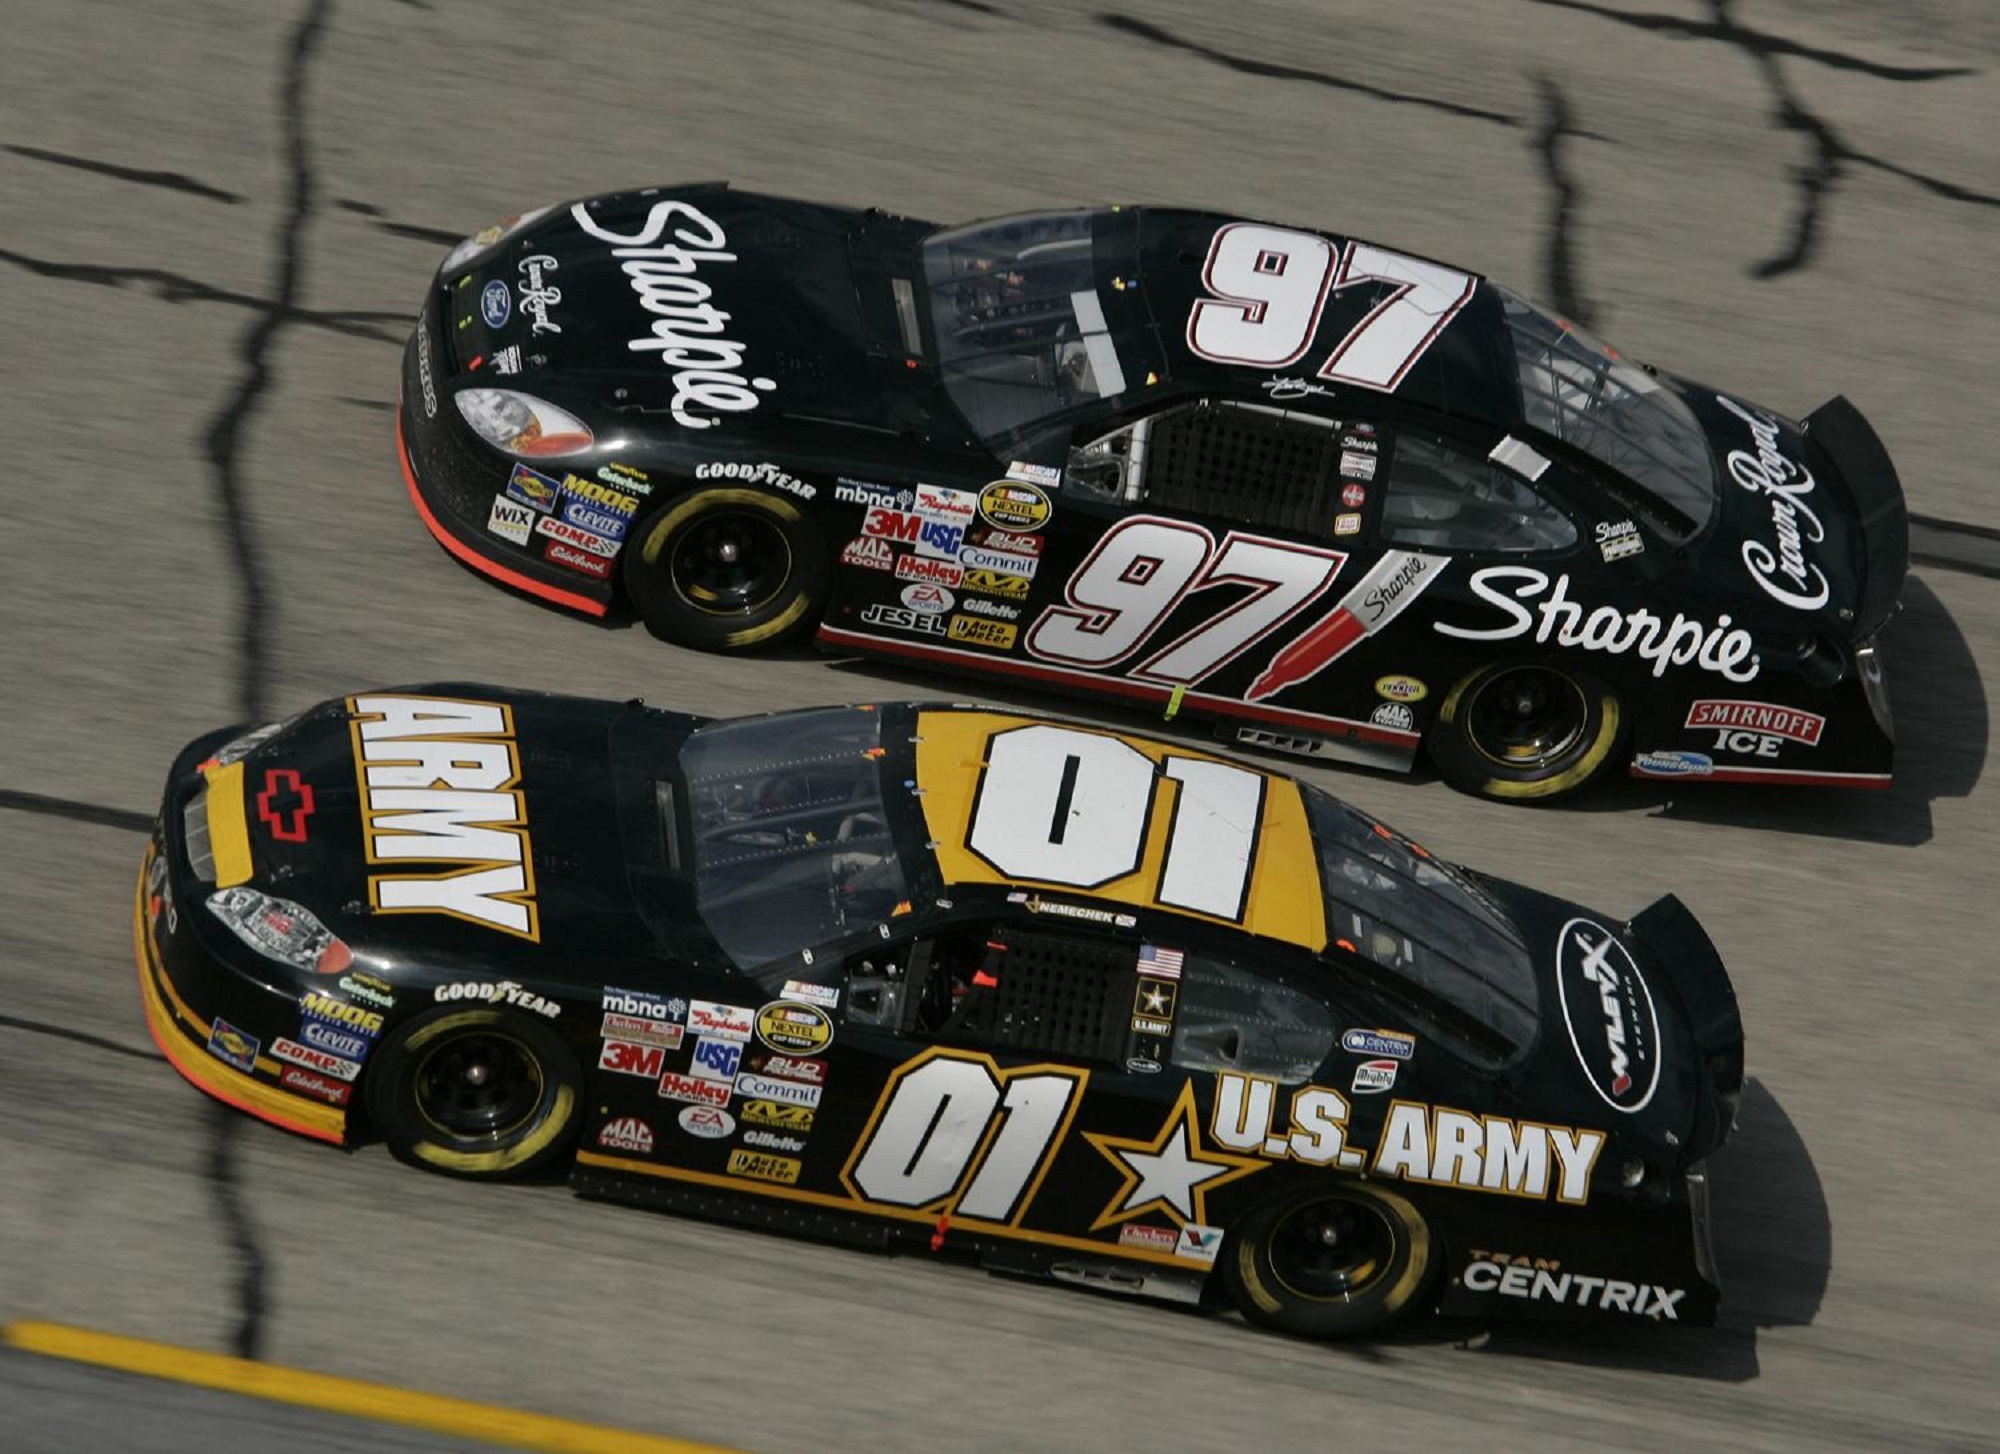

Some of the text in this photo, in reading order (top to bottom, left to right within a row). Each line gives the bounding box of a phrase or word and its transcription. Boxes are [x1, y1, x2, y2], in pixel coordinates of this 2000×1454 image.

[571, 200, 777, 429] Sharpie
[1187, 223, 1477, 393] 97
[563, 474, 640, 513] MOOG
[696, 462, 817, 500] GOODYEAR
[834, 485, 896, 509] mbna
[992, 500, 1034, 515] NEXTEL
[495, 505, 529, 526] WIX
[568, 503, 622, 533] CLEVITE
[865, 509, 922, 541] 3M
[541, 518, 599, 548] COMP
[921, 521, 963, 555] USG
[987, 531, 1036, 547] BUD
[842, 555, 892, 571] TOOLS
[843, 537, 893, 561] MAC
[958, 548, 1034, 574] Commit
[898, 556, 962, 587] Holley
[912, 584, 943, 604] EA
[1024, 514, 1349, 687] 97
[1363, 553, 1427, 622] Sharpie
[908, 598, 944, 612] SPORTS
[963, 597, 1018, 619] Gillette
[861, 604, 947, 636] JESEL
[972, 621, 1005, 634] Auto
[1433, 565, 1760, 683] Sharpie
[965, 628, 1010, 644] Meter
[1695, 704, 1816, 738] SMIRNOFF
[1713, 729, 1784, 758] ICE
[345, 694, 541, 943] ARMY
[965, 723, 1268, 925] 01
[1040, 902, 1114, 923] NEMECHEK
[300, 992, 385, 1031] MOOG
[434, 981, 562, 1019] GOODYEAR
[602, 994, 667, 1019] mbna
[306, 1023, 363, 1054] CLEVITE
[771, 1021, 816, 1037] NEXTEL
[275, 1041, 337, 1068] COMP
[603, 1042, 663, 1076] 3M
[696, 1041, 739, 1077] USG
[768, 1056, 820, 1073] BUD
[662, 1074, 728, 1104] Holley
[737, 1075, 816, 1103] Commit
[603, 1118, 653, 1143] MAC
[690, 1108, 724, 1128] EA
[601, 1136, 652, 1152] TOOLS
[743, 1130, 802, 1151] Gillette
[844, 1049, 1086, 1225] 01
[1210, 1070, 1607, 1205] U.S. ARMY
[750, 1163, 794, 1179] Meter
[754, 1155, 789, 1169] Auto
[1470, 1249, 1560, 1271] TEAM
[1463, 1261, 1686, 1320] CENTRIX
